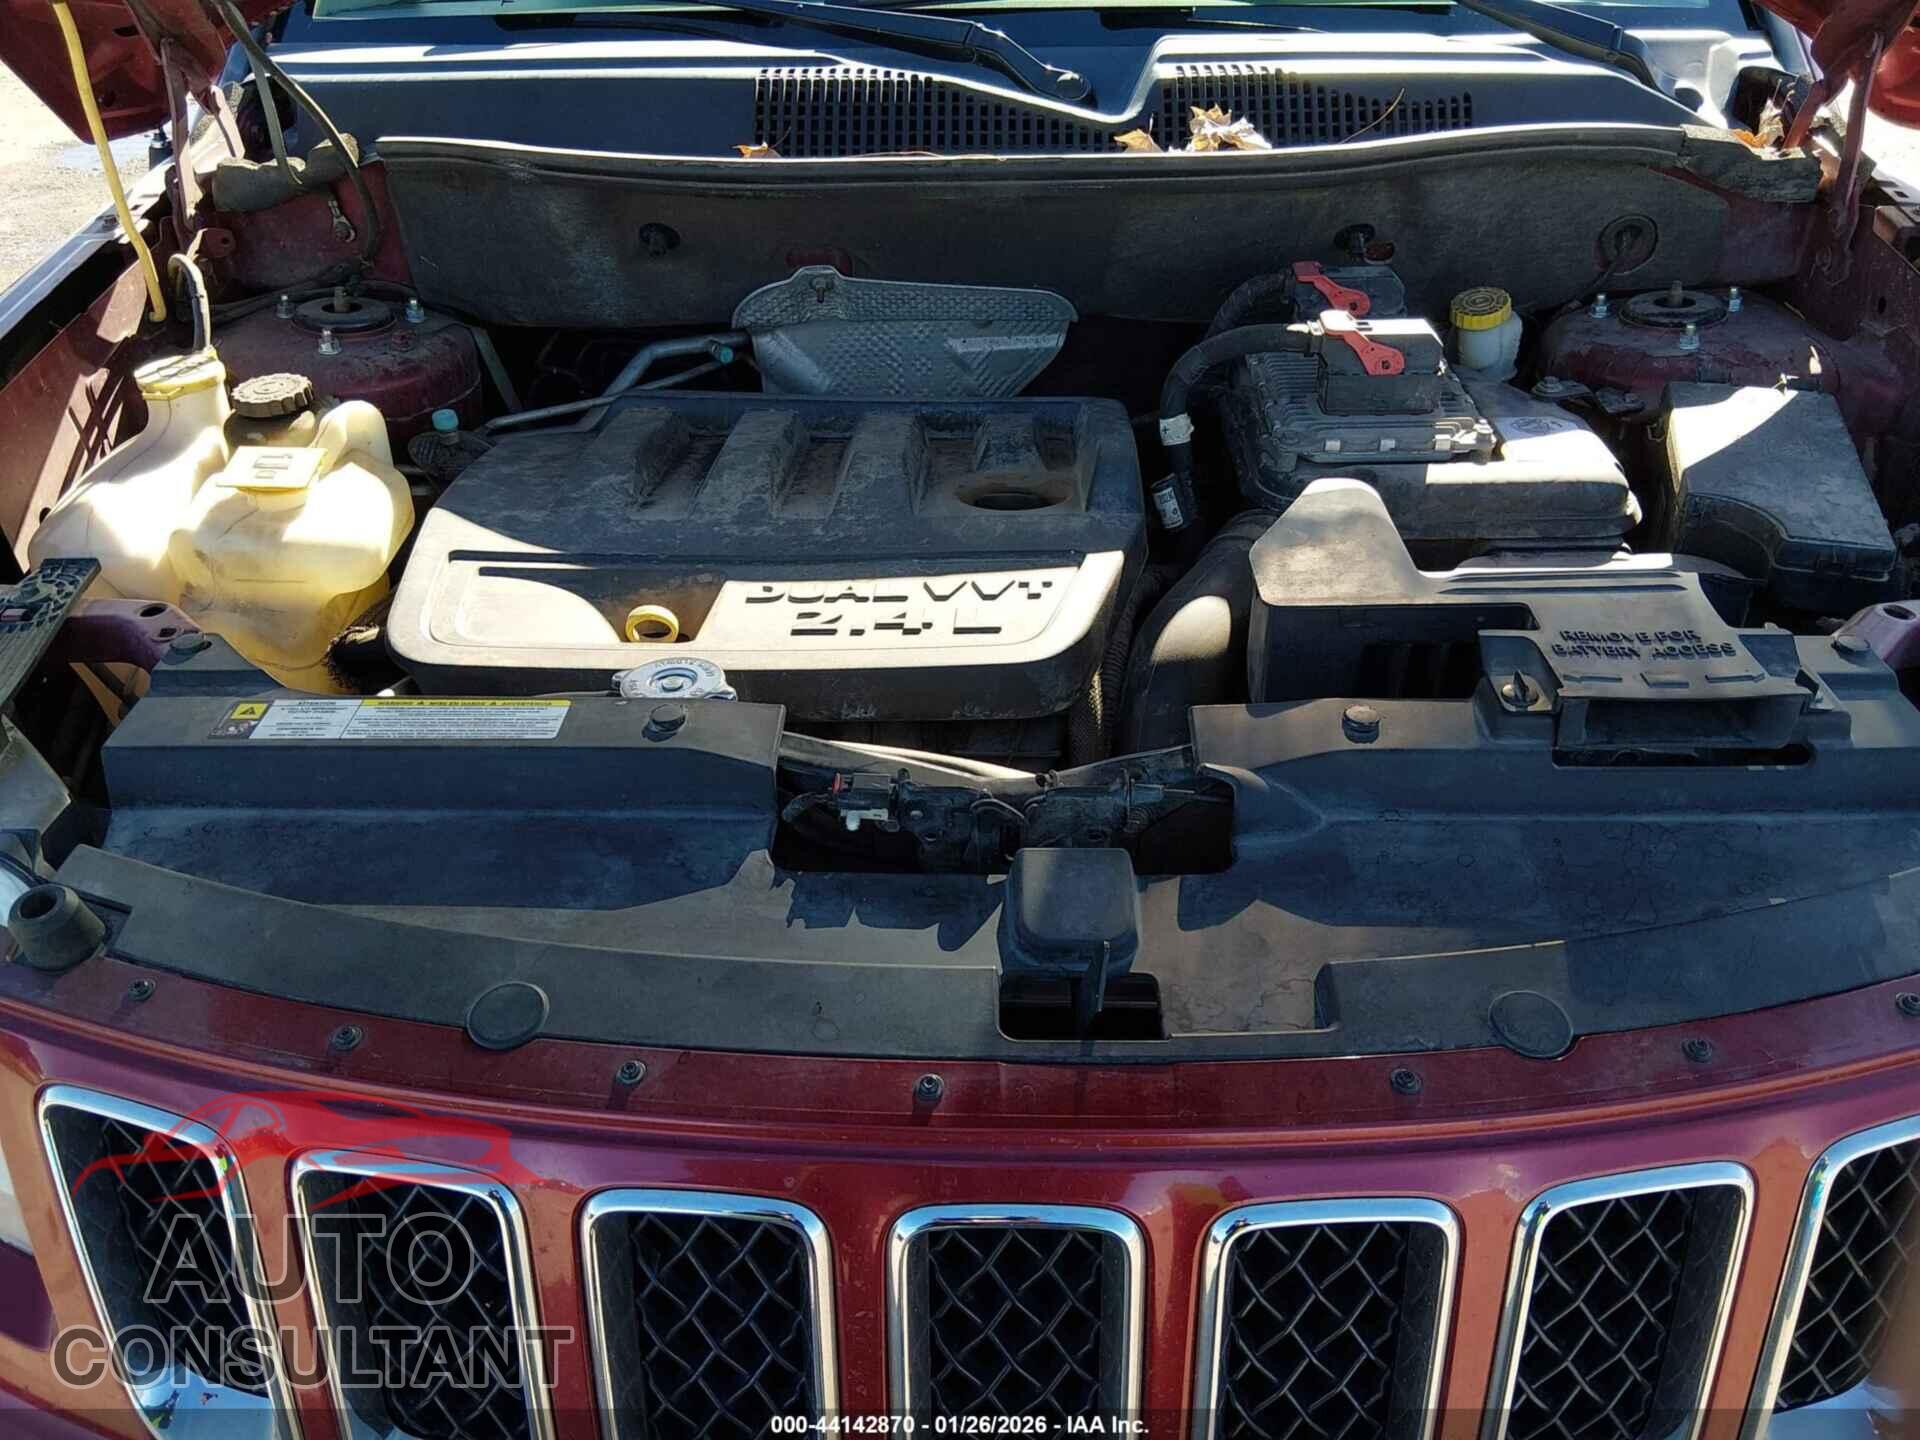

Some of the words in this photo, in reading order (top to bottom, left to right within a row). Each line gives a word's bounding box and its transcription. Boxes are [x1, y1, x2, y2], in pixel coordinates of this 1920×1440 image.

[745, 582, 909, 604] DUAL
[922, 579, 1053, 602] VVT
[1558, 630, 1651, 645] REMOVE
[1653, 629, 1702, 645] FOR
[1651, 642, 1736, 660] ACCESS
